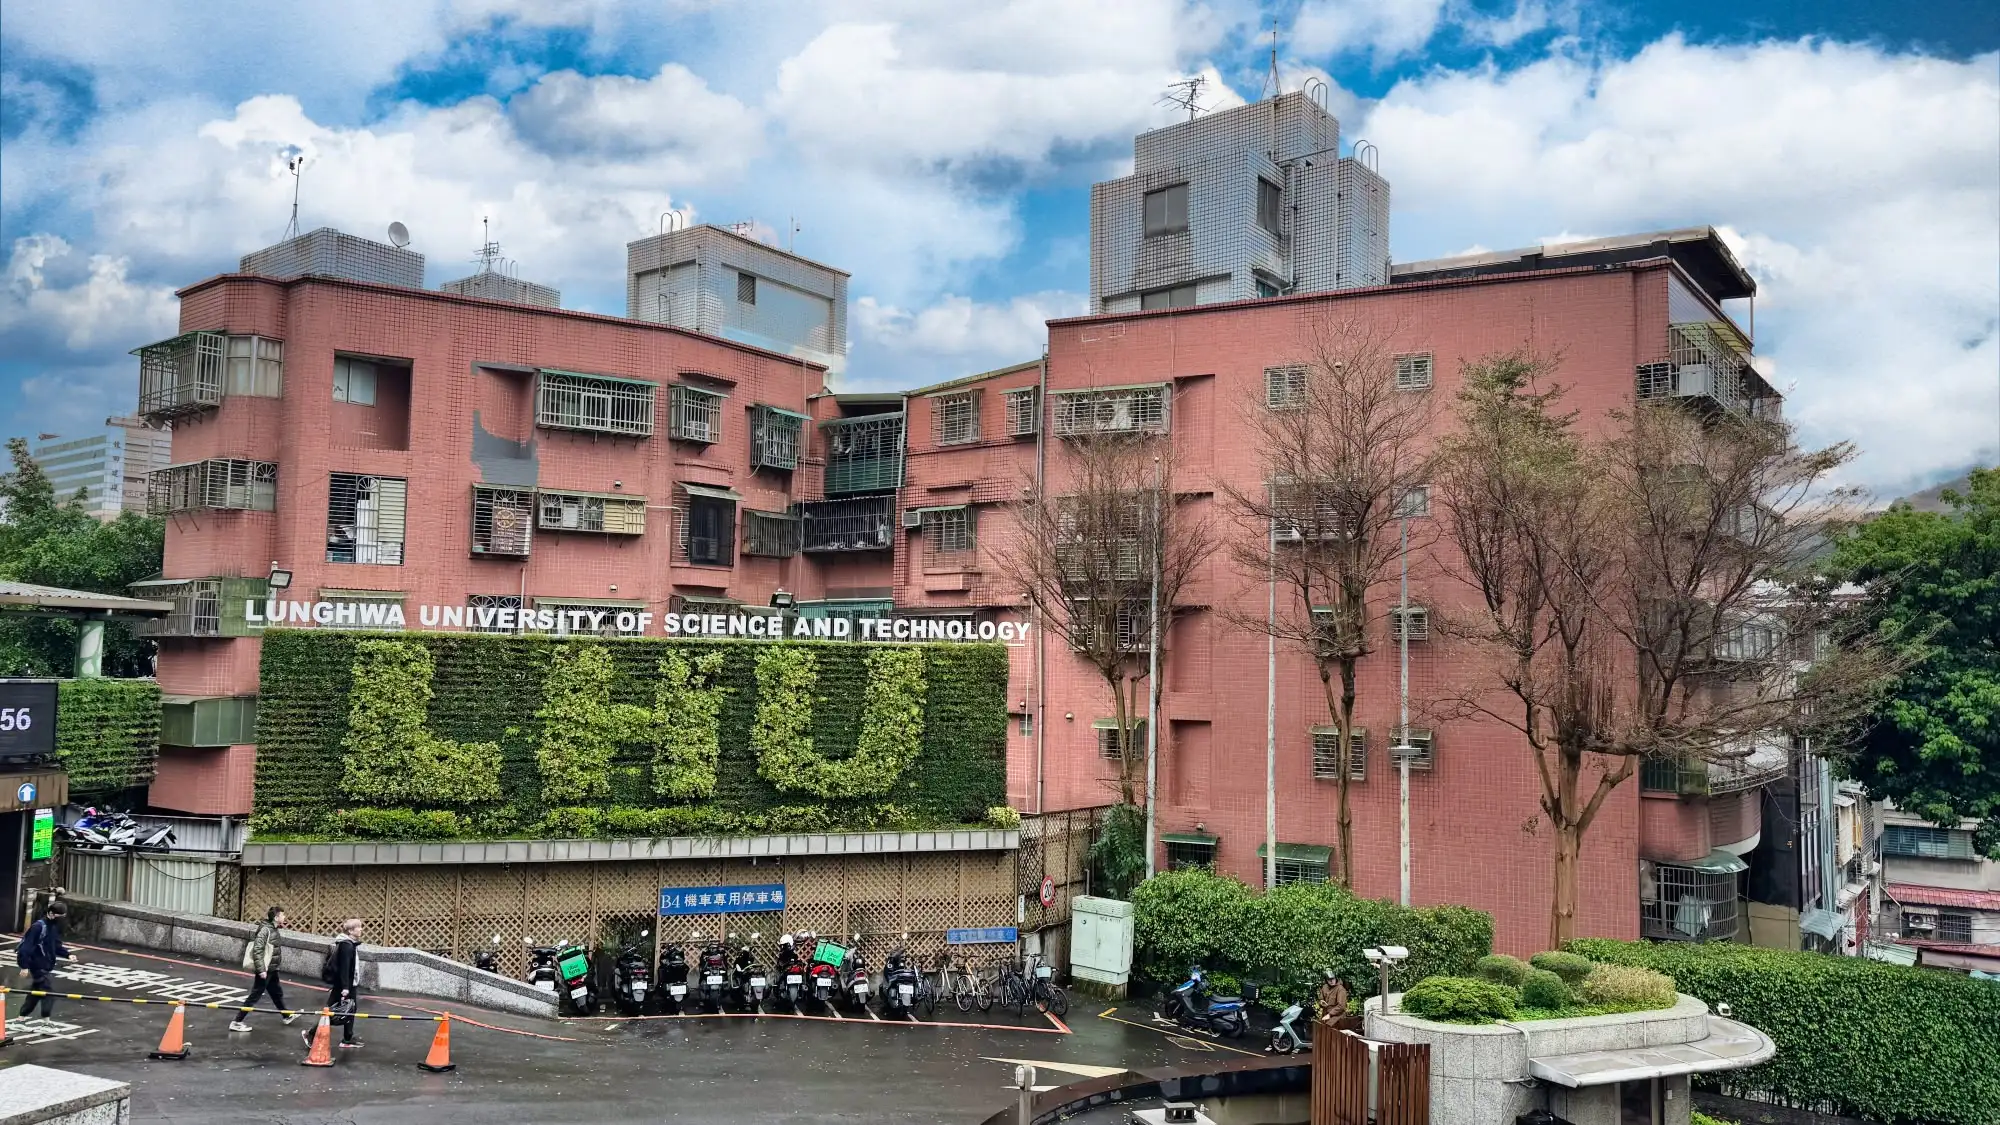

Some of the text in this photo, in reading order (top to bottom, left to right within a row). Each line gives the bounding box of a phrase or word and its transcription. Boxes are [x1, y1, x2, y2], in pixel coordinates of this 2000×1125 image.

[245, 599, 1031, 641] LUNGHWA UNIVERSITY OF SCIENCE AND TECHNOLOGY
[0, 707, 31, 731] 56
[341, 640, 926, 801] LHU
[661, 890, 784, 909] B4 機車專用停車場
[1044, 883, 1052, 898] 20
